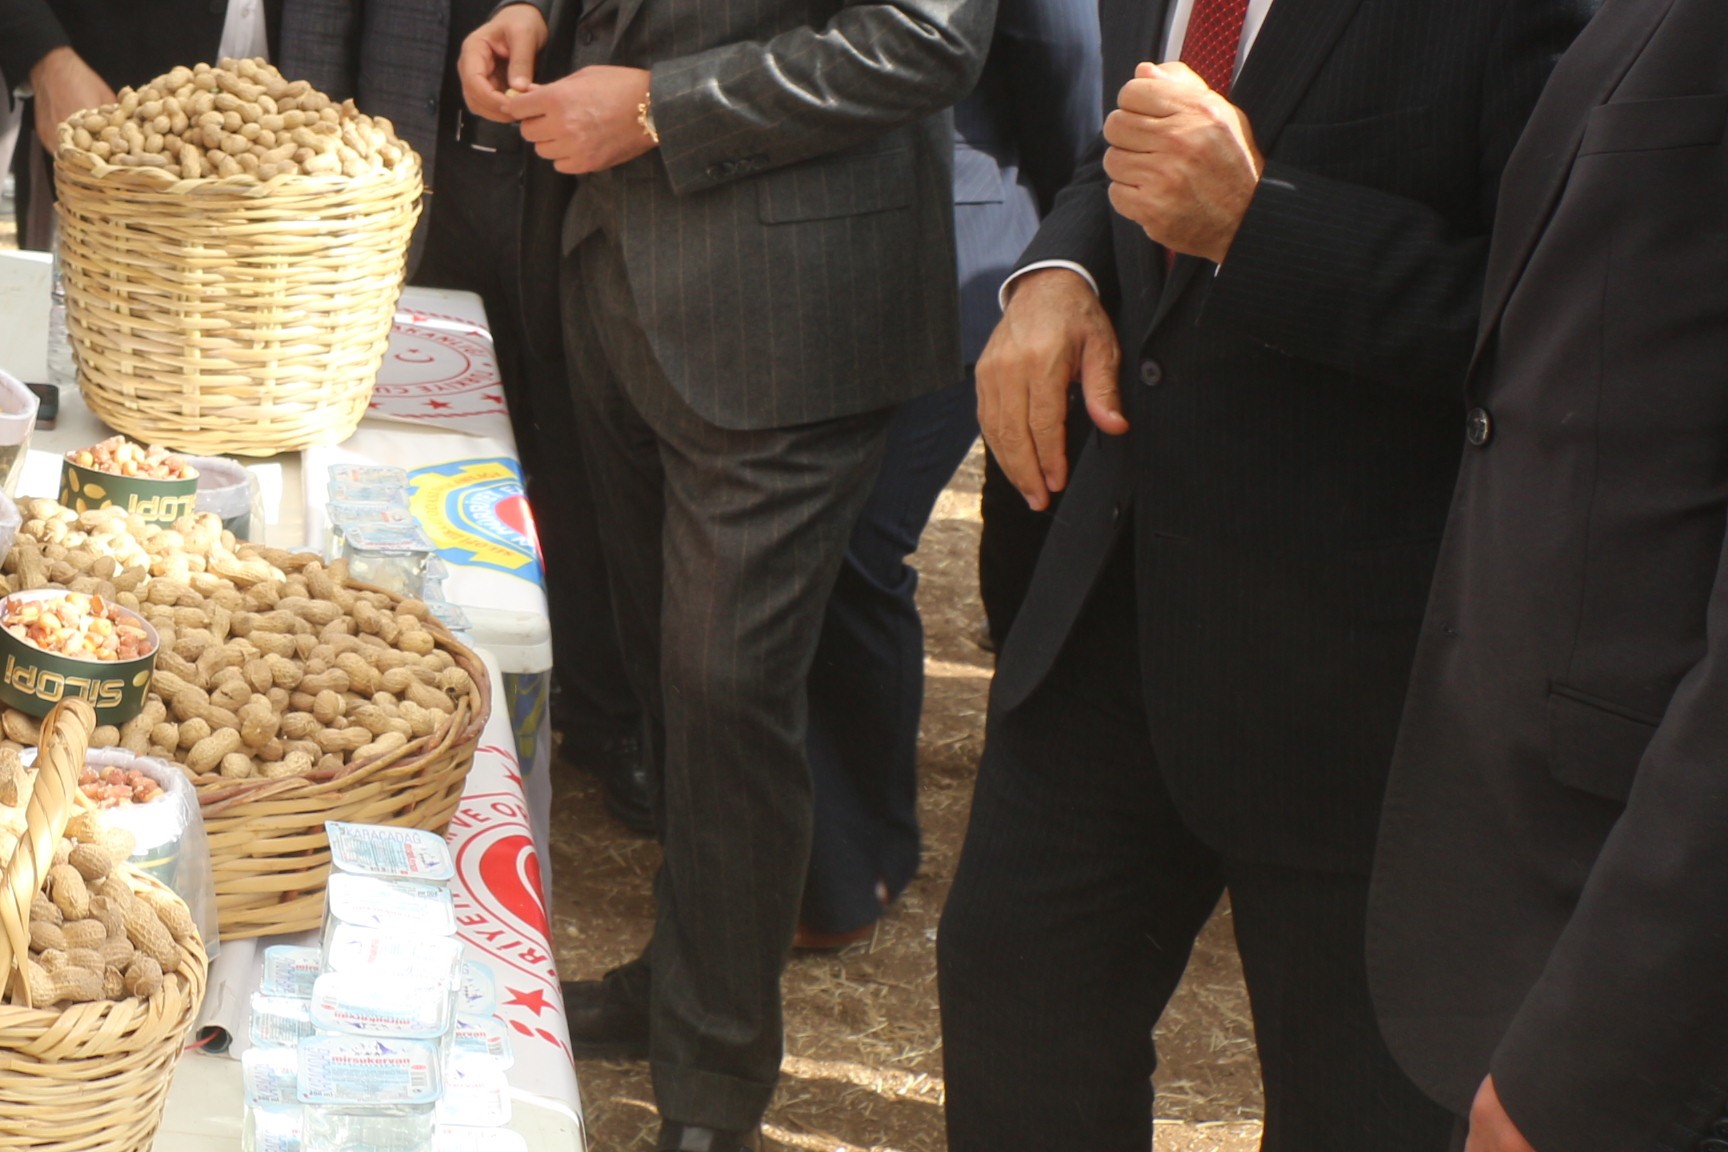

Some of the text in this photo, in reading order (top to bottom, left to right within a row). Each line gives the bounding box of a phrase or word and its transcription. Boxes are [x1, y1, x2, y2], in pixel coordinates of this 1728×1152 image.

[374, 385, 409, 395] CU
[345, 826, 421, 844] KARACADAĞ
[331, 1054, 411, 1065] mirsukervan
